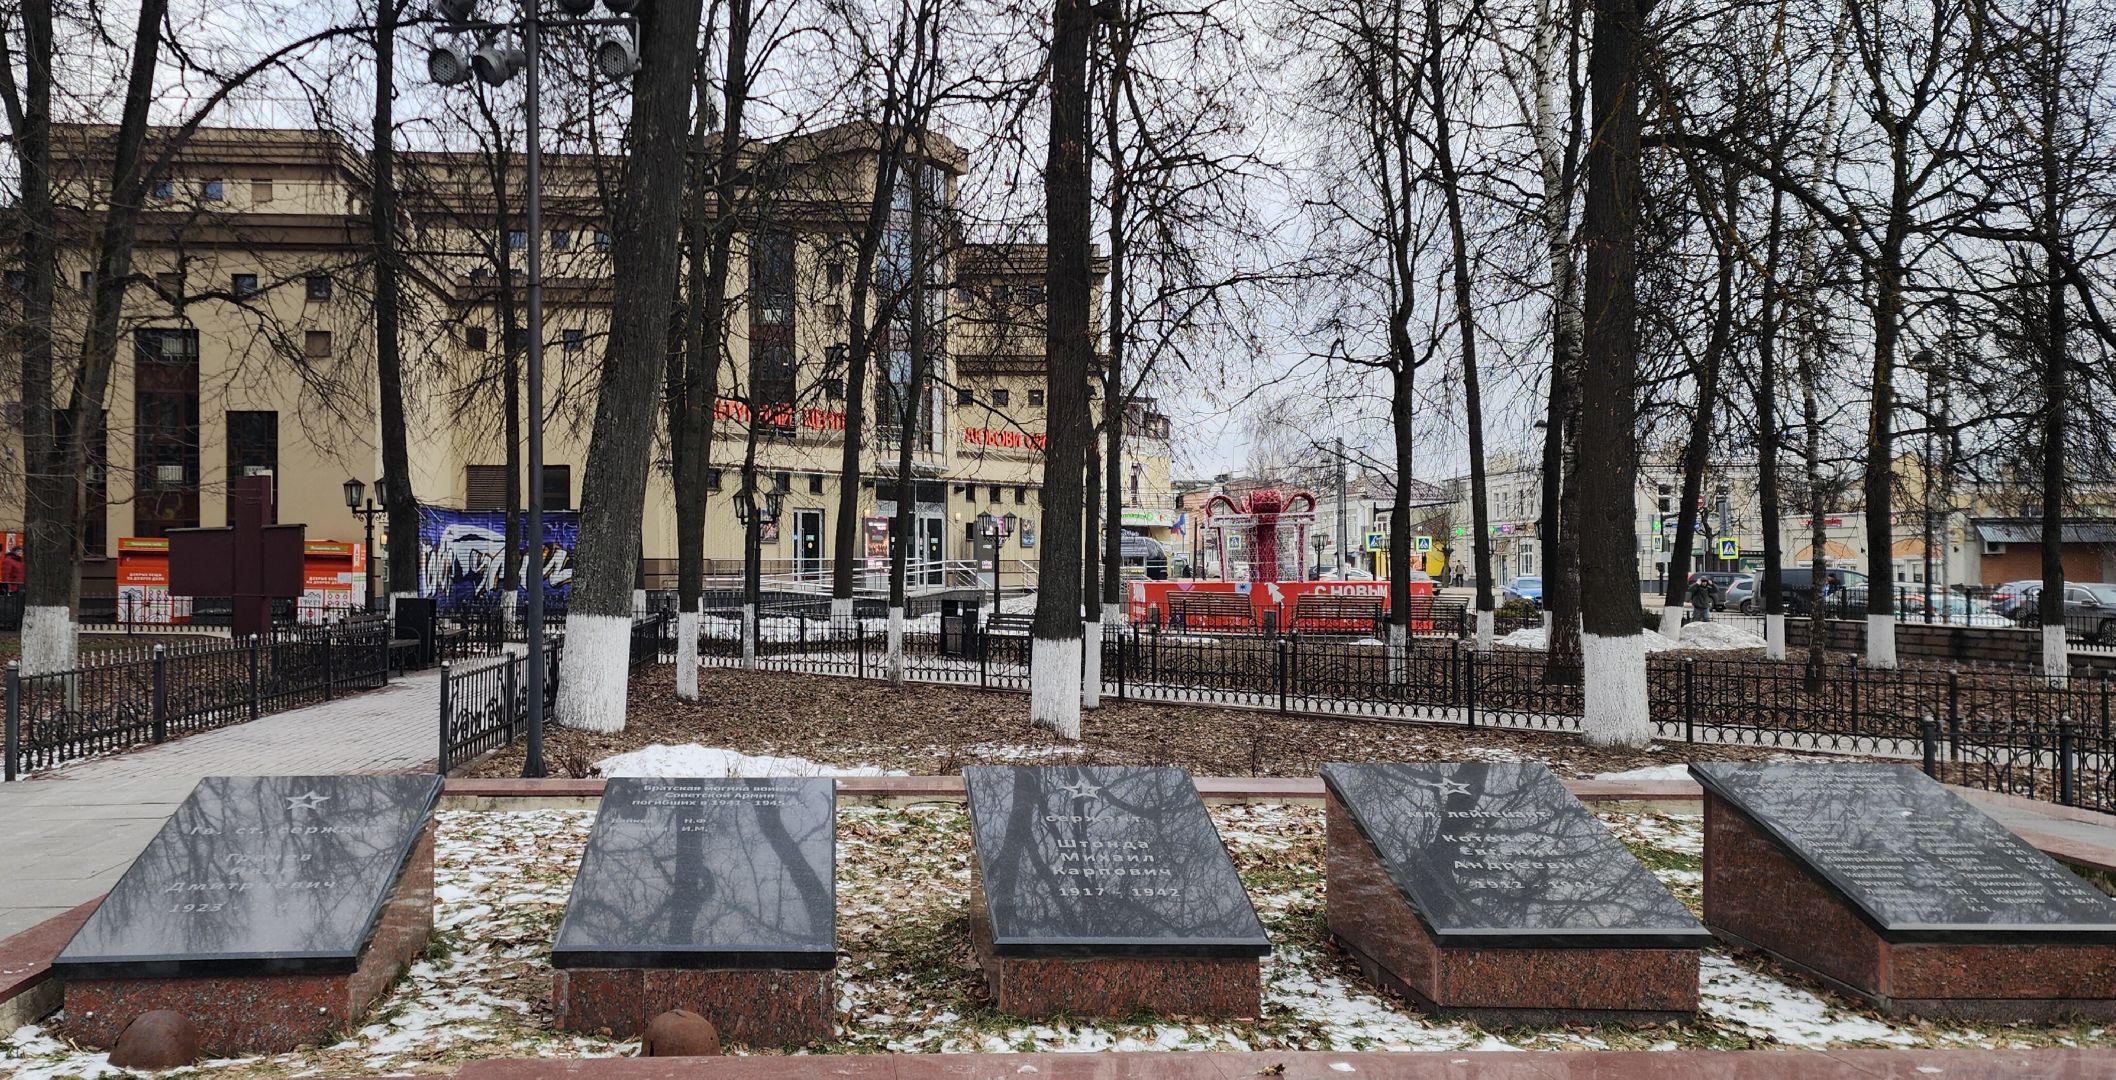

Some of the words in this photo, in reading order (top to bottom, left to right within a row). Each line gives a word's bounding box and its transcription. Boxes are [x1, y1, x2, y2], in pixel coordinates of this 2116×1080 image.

[964, 427, 1022, 448] ЛЮБОВИ
[1314, 585, 1327, 597] С
[1331, 584, 1388, 597] НОВЫМ
[1060, 852, 1155, 862] Михаил
[1454, 860, 1592, 871] Андреевич
[1053, 867, 1172, 877] Карпович
[1058, 888, 1104, 896] 1917
[1132, 888, 1181, 897] 1942
[169, 903, 223, 913] 1923
